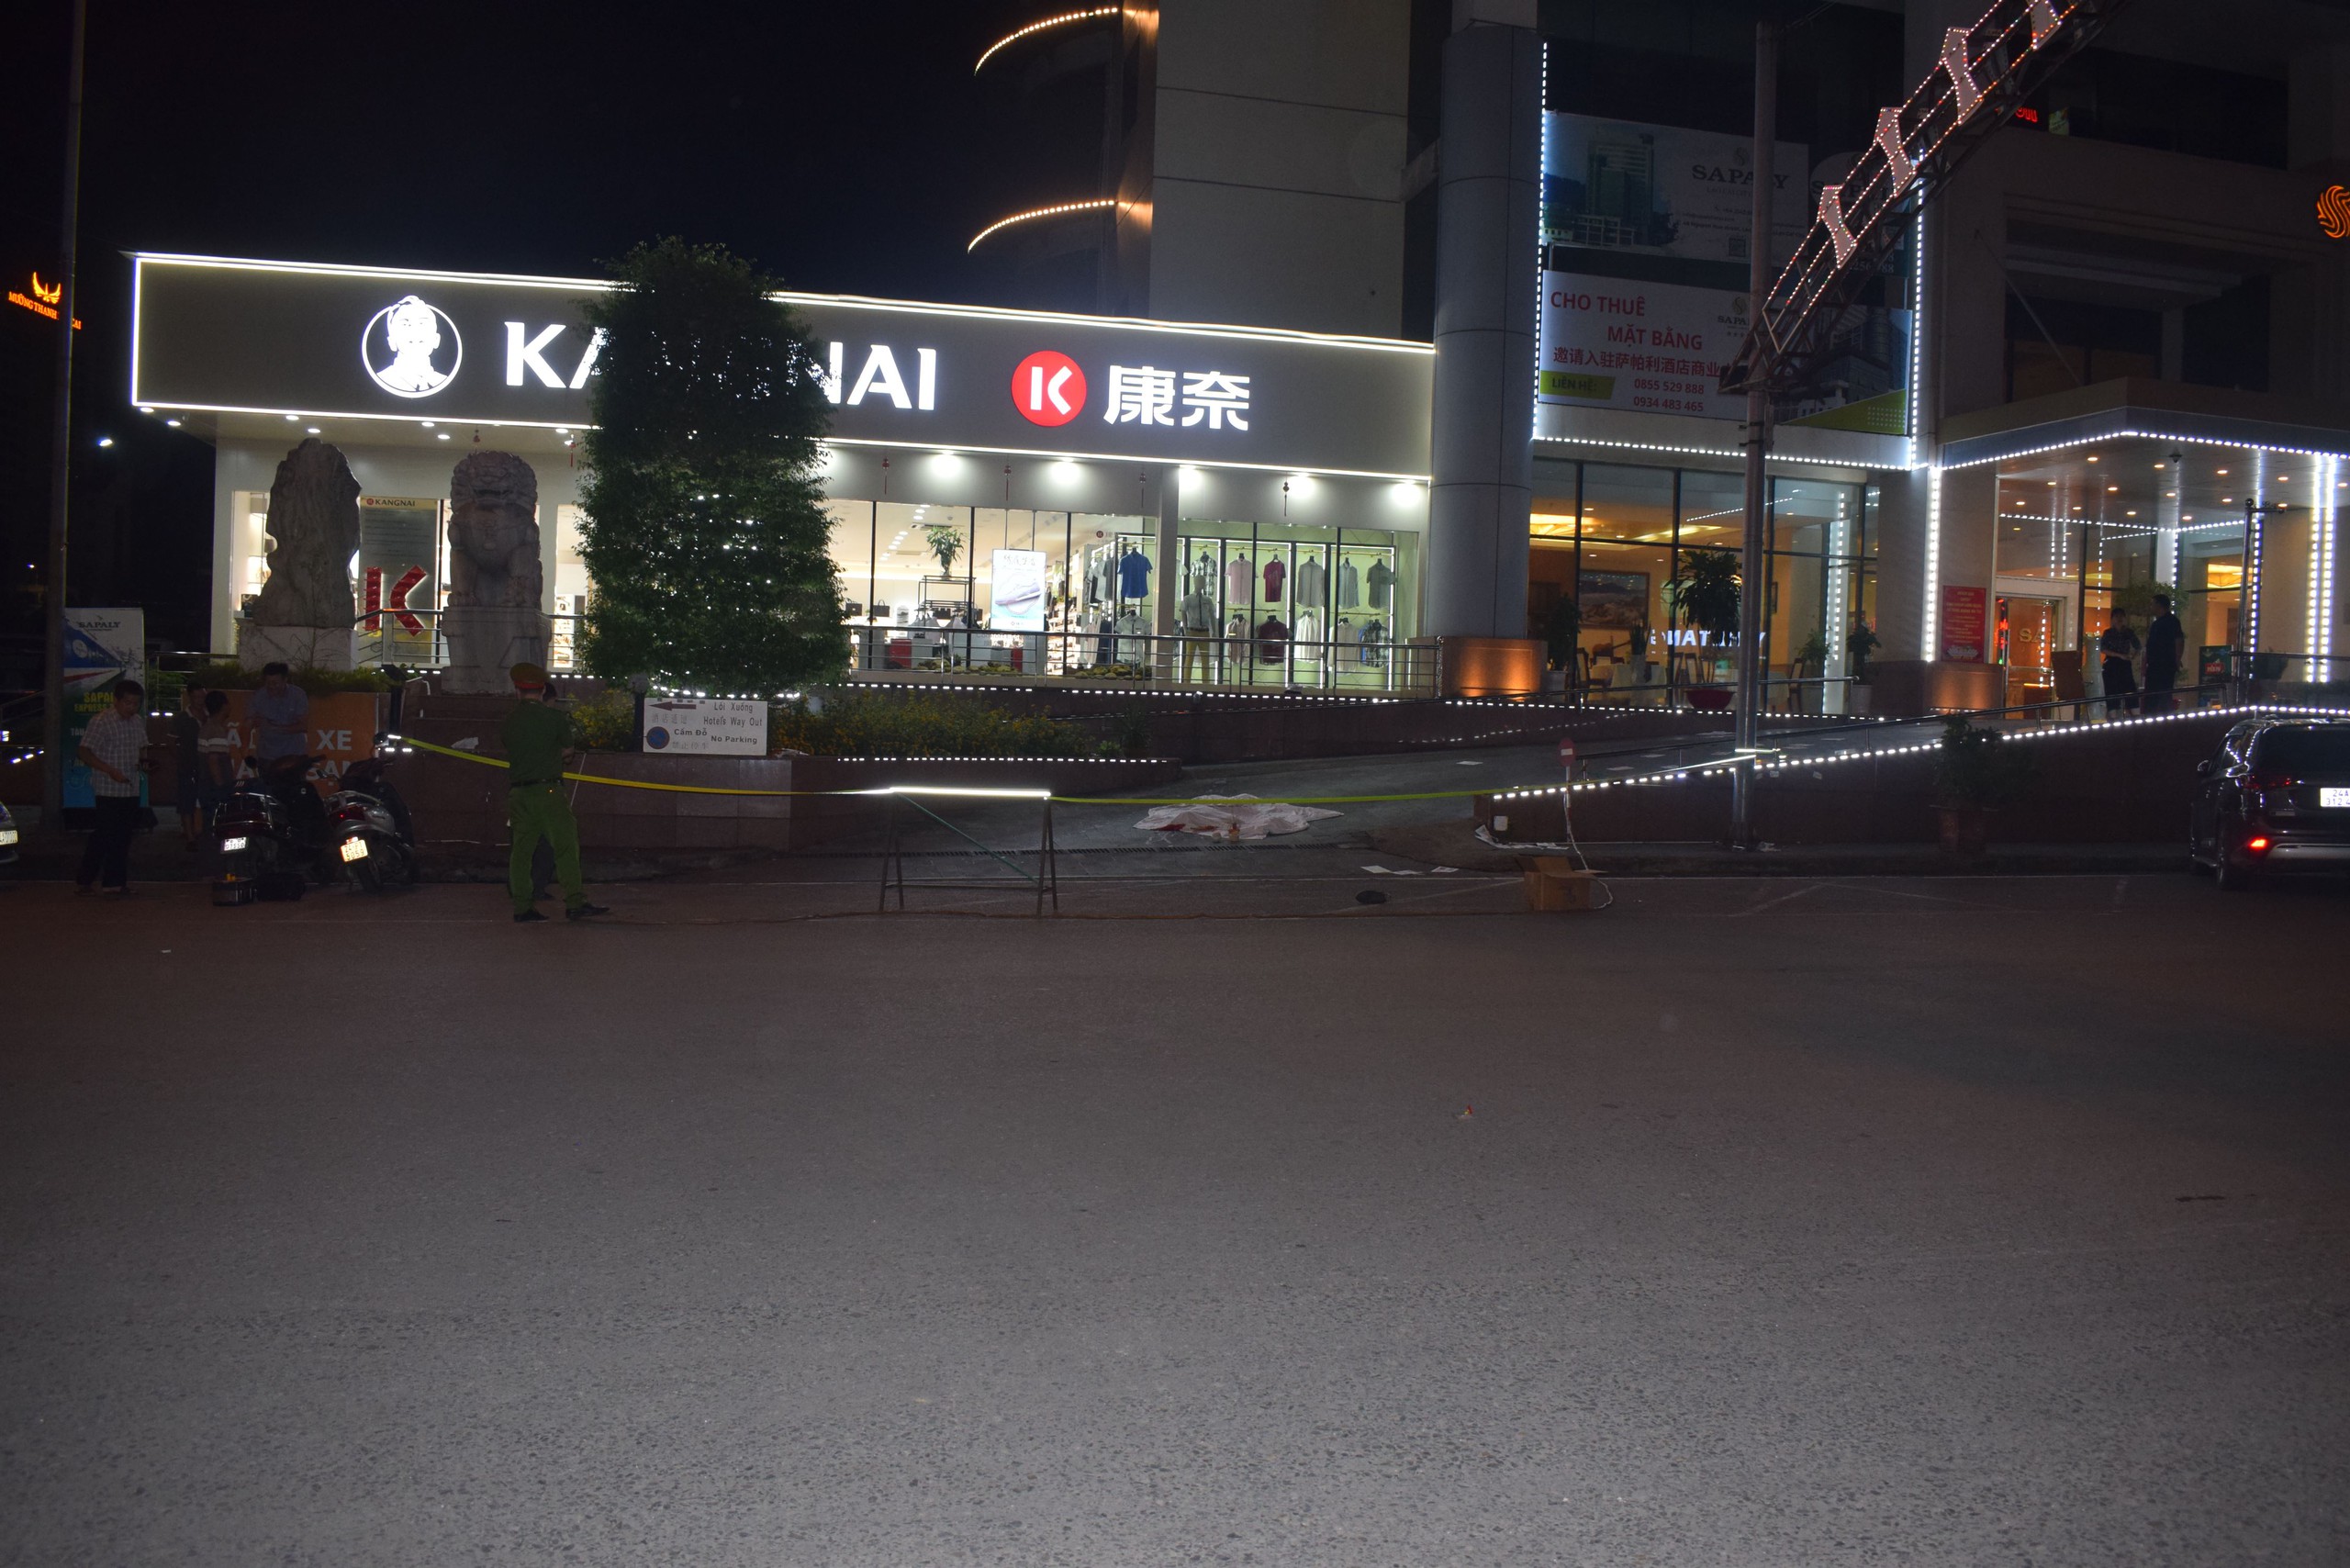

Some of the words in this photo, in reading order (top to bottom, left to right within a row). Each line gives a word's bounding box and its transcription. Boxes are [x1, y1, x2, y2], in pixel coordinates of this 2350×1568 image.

[1692, 164, 1790, 189] SAPAY
[1550, 291, 1592, 310] CHO
[1597, 296, 1646, 317] THUÊ
[1634, 378, 1660, 390] 0855
[1662, 381, 1683, 392] 529
[1684, 383, 1705, 395] 888
[1103, 364, 1250, 431] 康奈
[1633, 396, 1660, 408] 0934
[1662, 398, 1681, 410] 483
[1684, 401, 1704, 412] 465
[375, 498, 416, 508] KANGNAI
[731, 717, 746, 728] Way
[749, 718, 763, 726] Out
[316, 729, 352, 751] XE
[725, 735, 757, 745] Parking
